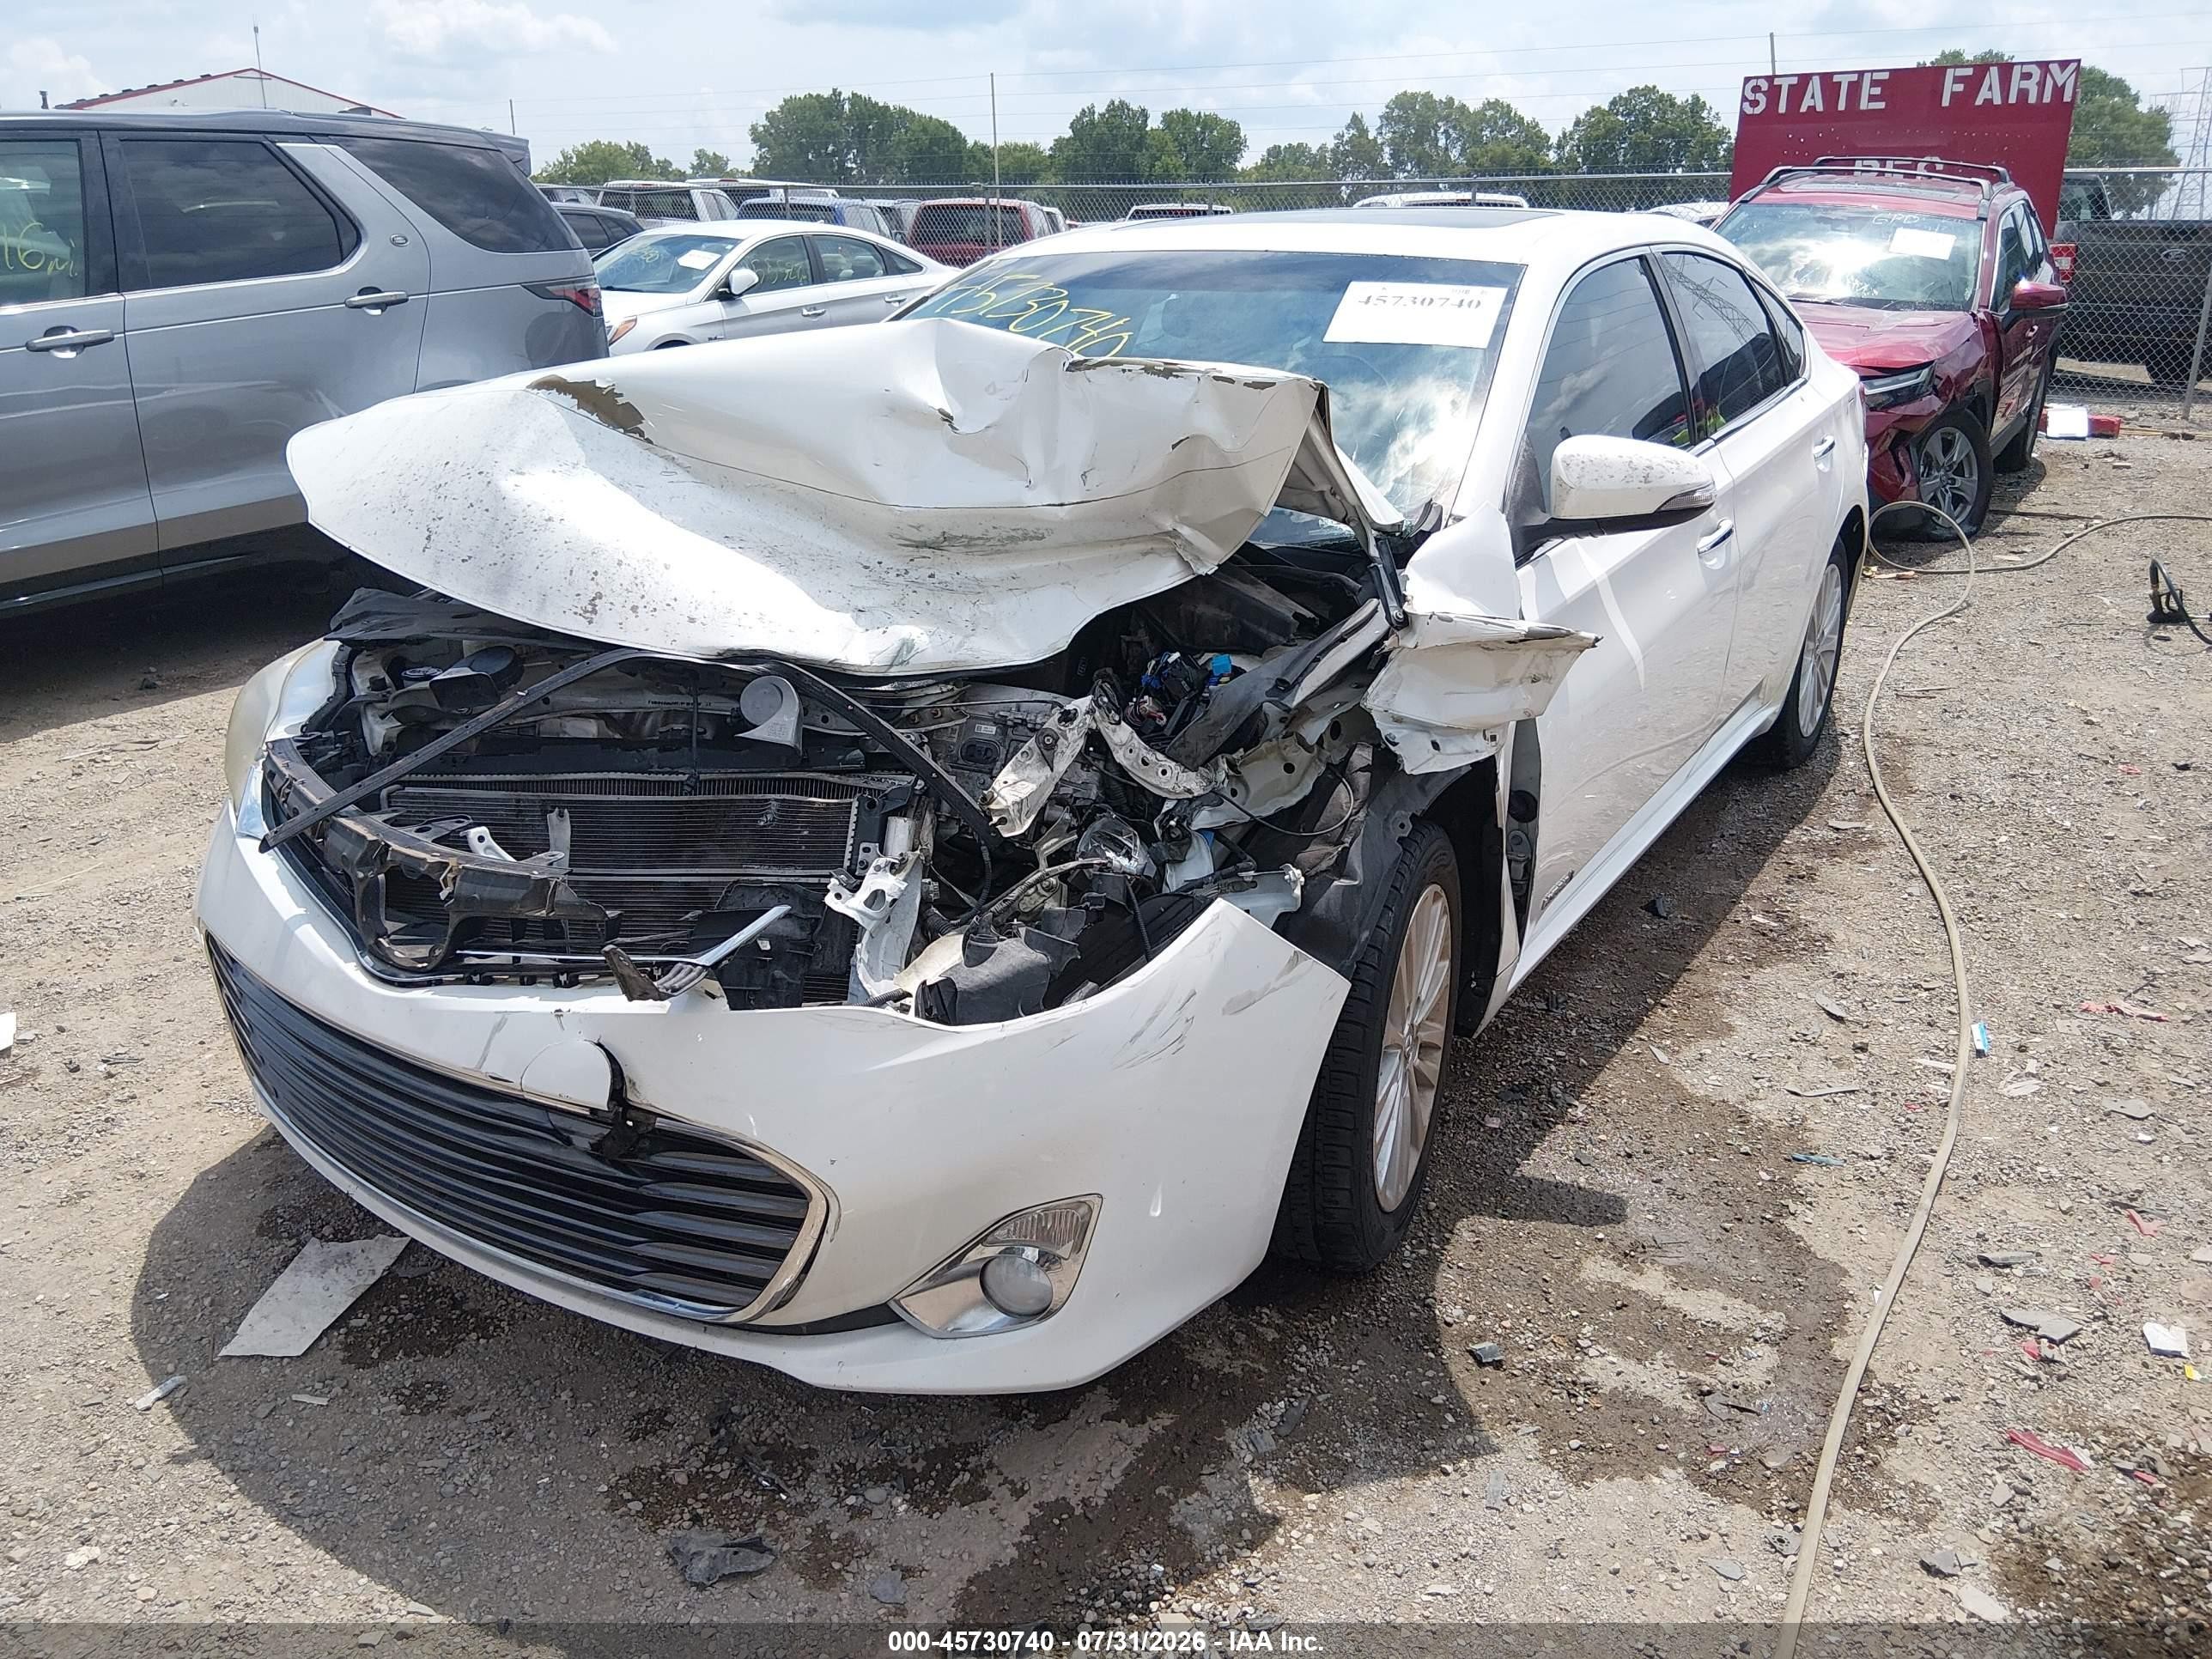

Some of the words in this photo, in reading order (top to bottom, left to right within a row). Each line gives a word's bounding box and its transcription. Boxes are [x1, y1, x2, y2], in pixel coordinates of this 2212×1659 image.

[1742, 71, 1889, 115] STATE
[1941, 62, 2078, 107] FARM
[1358, 295, 1482, 309] 45730740
